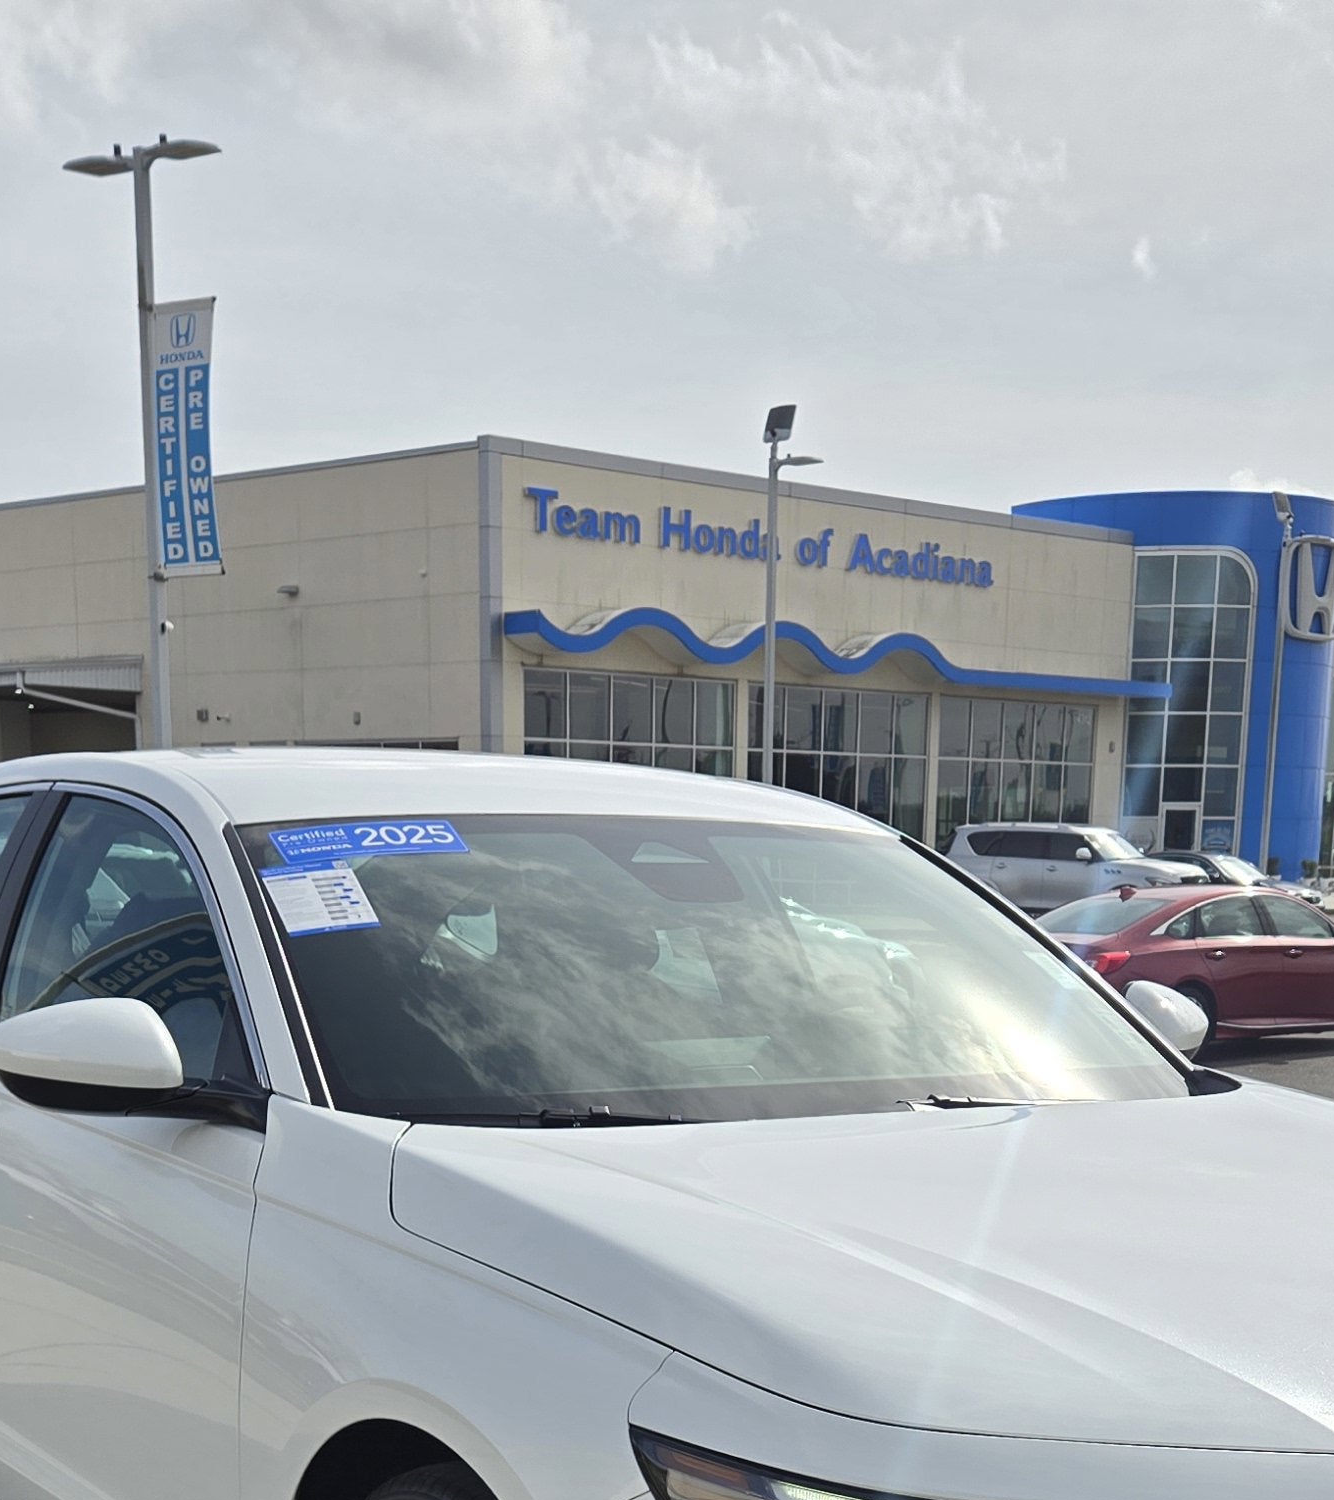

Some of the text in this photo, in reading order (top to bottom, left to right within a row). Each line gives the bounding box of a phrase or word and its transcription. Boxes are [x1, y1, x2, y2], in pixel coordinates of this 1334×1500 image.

[159, 349, 205, 365] HONDA
[158, 373, 185, 560] CERTIFIED
[188, 369, 213, 557] PRE OWNED
[524, 487, 641, 544] Team
[795, 528, 834, 568] of
[845, 533, 994, 588] Acadiana
[277, 824, 455, 847] Certified 2025
[300, 843, 354, 854] HONDA
